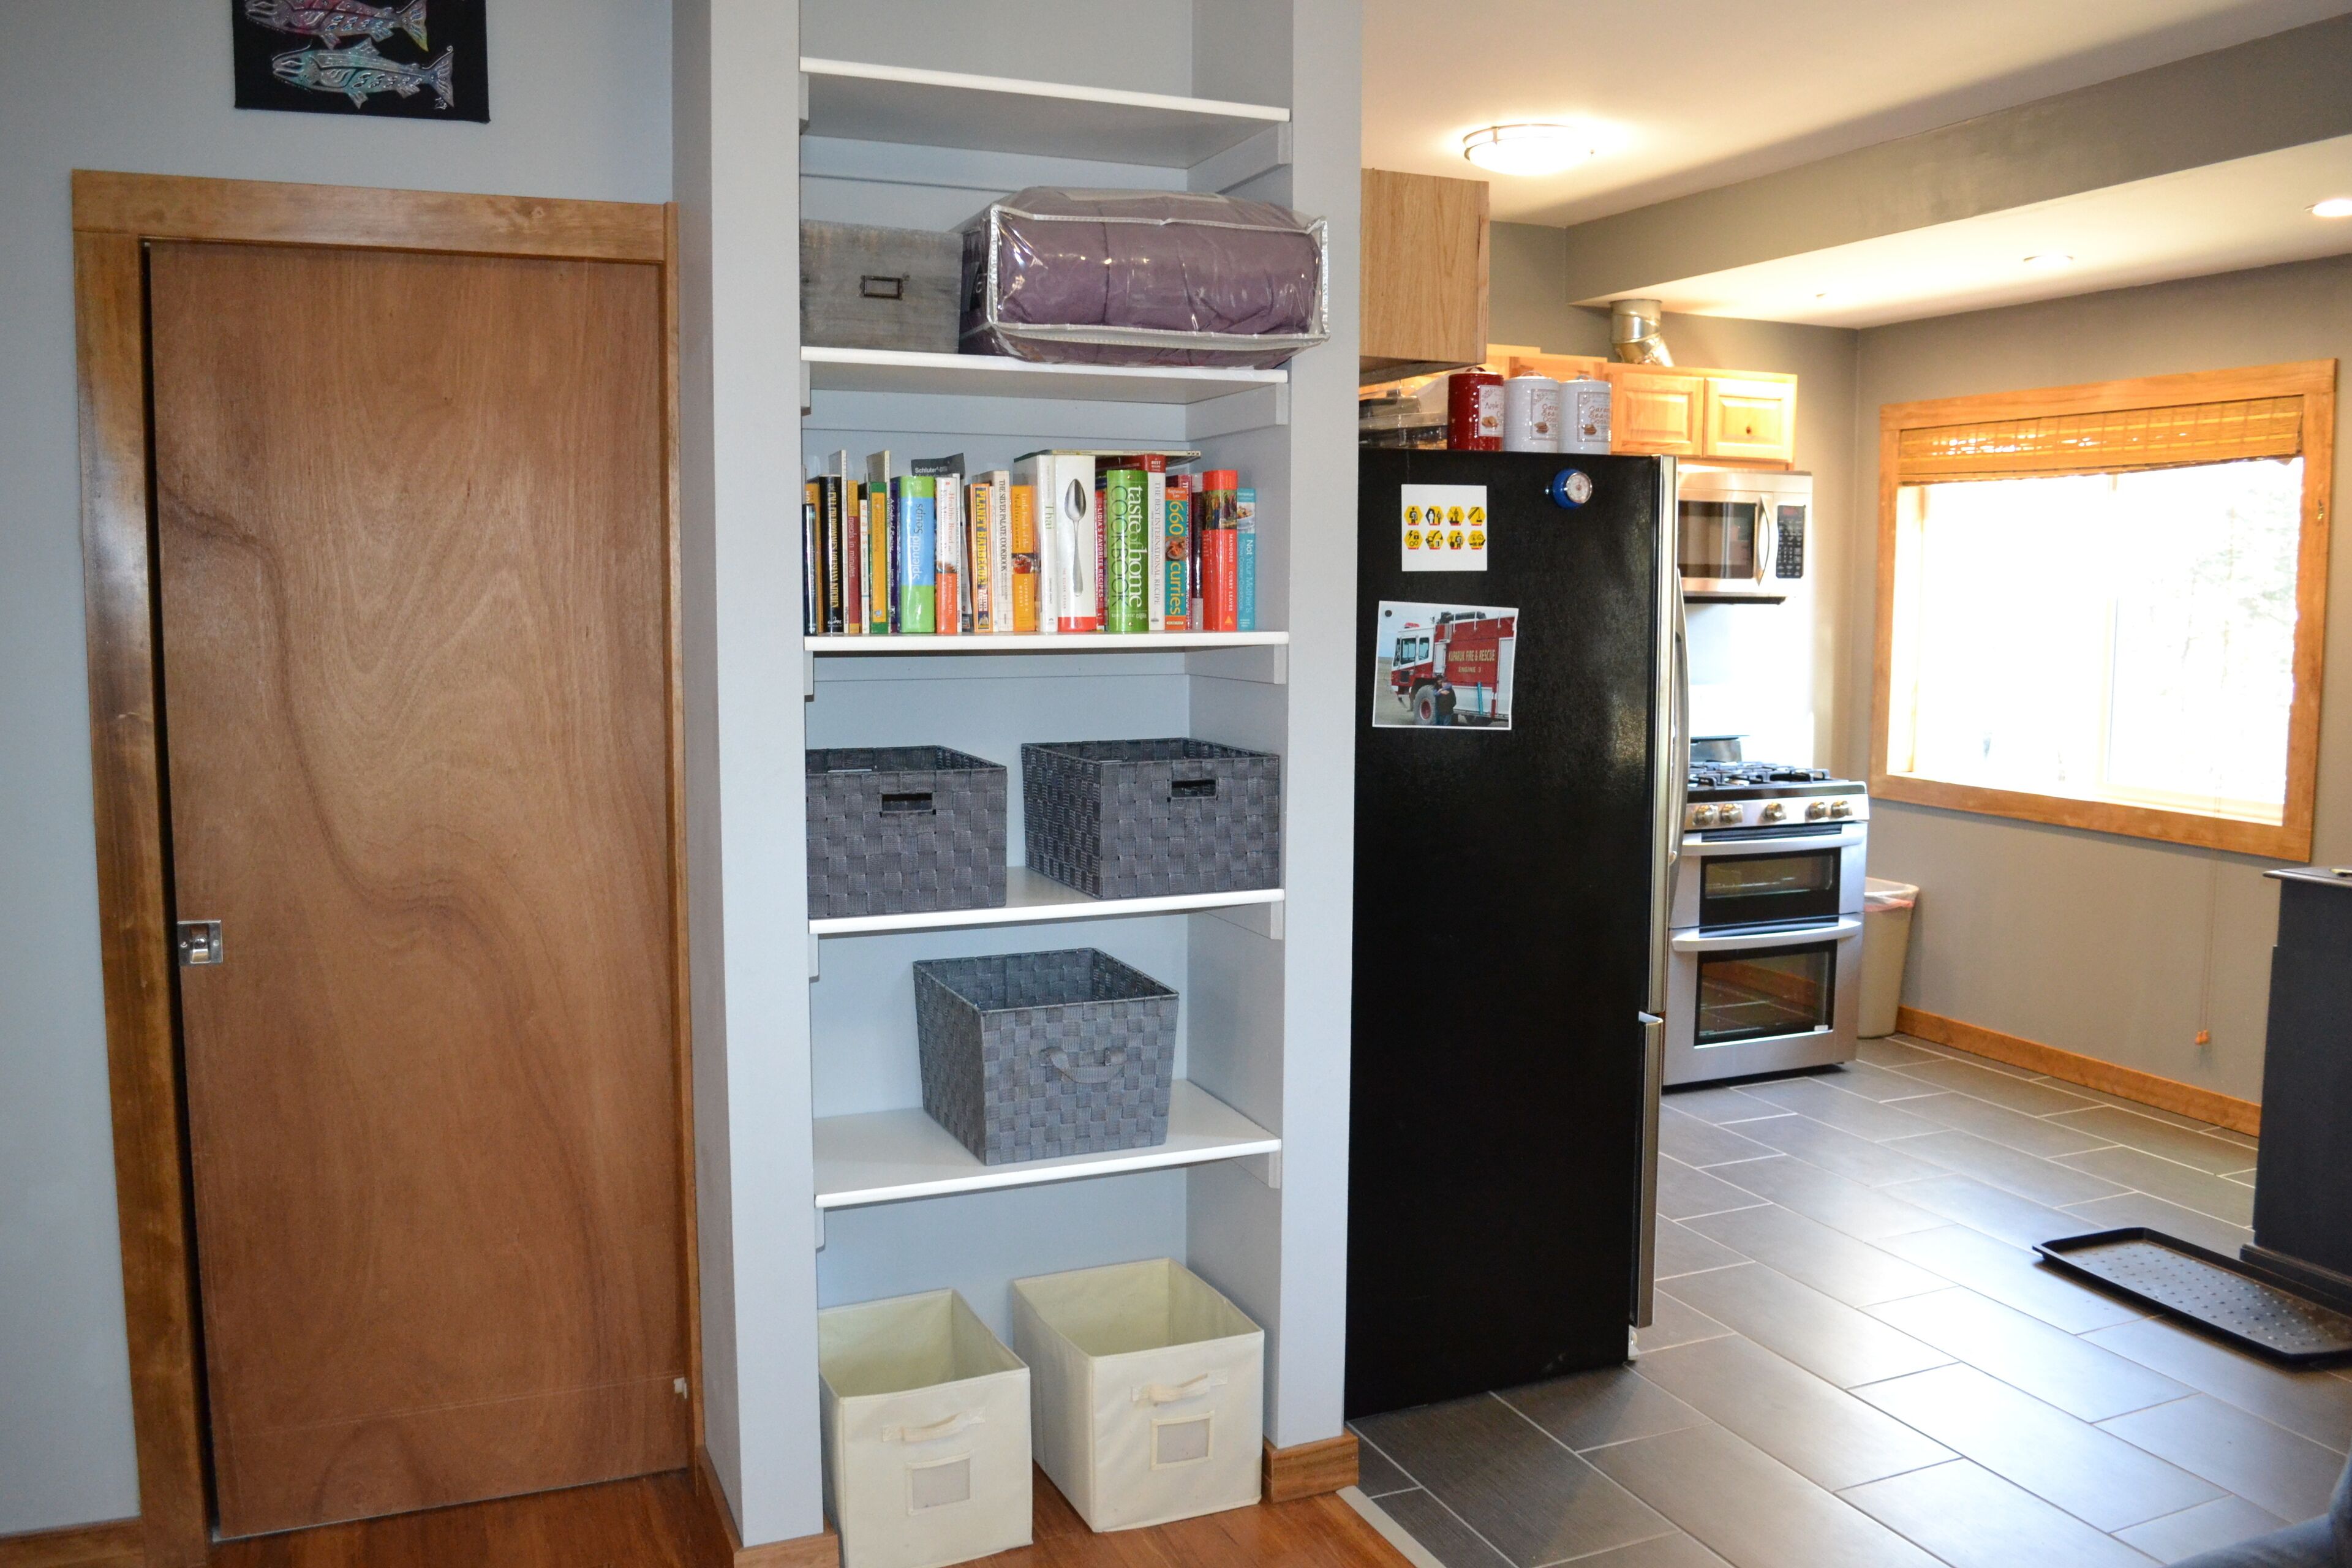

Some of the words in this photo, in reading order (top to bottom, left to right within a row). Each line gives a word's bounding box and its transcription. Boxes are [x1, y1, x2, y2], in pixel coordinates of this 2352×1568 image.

[913, 503, 925, 534] Soups
[977, 490, 987, 529] PLANET
[1045, 502, 1054, 530] Thai
[1128, 485, 1144, 533] taste
[1169, 501, 1184, 535] 660
[911, 536, 922, 579] Splendid
[978, 530, 988, 585] BARBECUE!
[1111, 485, 1129, 608] COOKBOOK
[1129, 531, 1144, 550] of
[830, 582, 839, 608] KITCHEN
[1128, 548, 1148, 608] home
[1169, 562, 1184, 615] curries
[1466, 650, 1474, 662] FIRE
[1475, 650, 1478, 661] &
[1479, 649, 1495, 662] RESCUE
